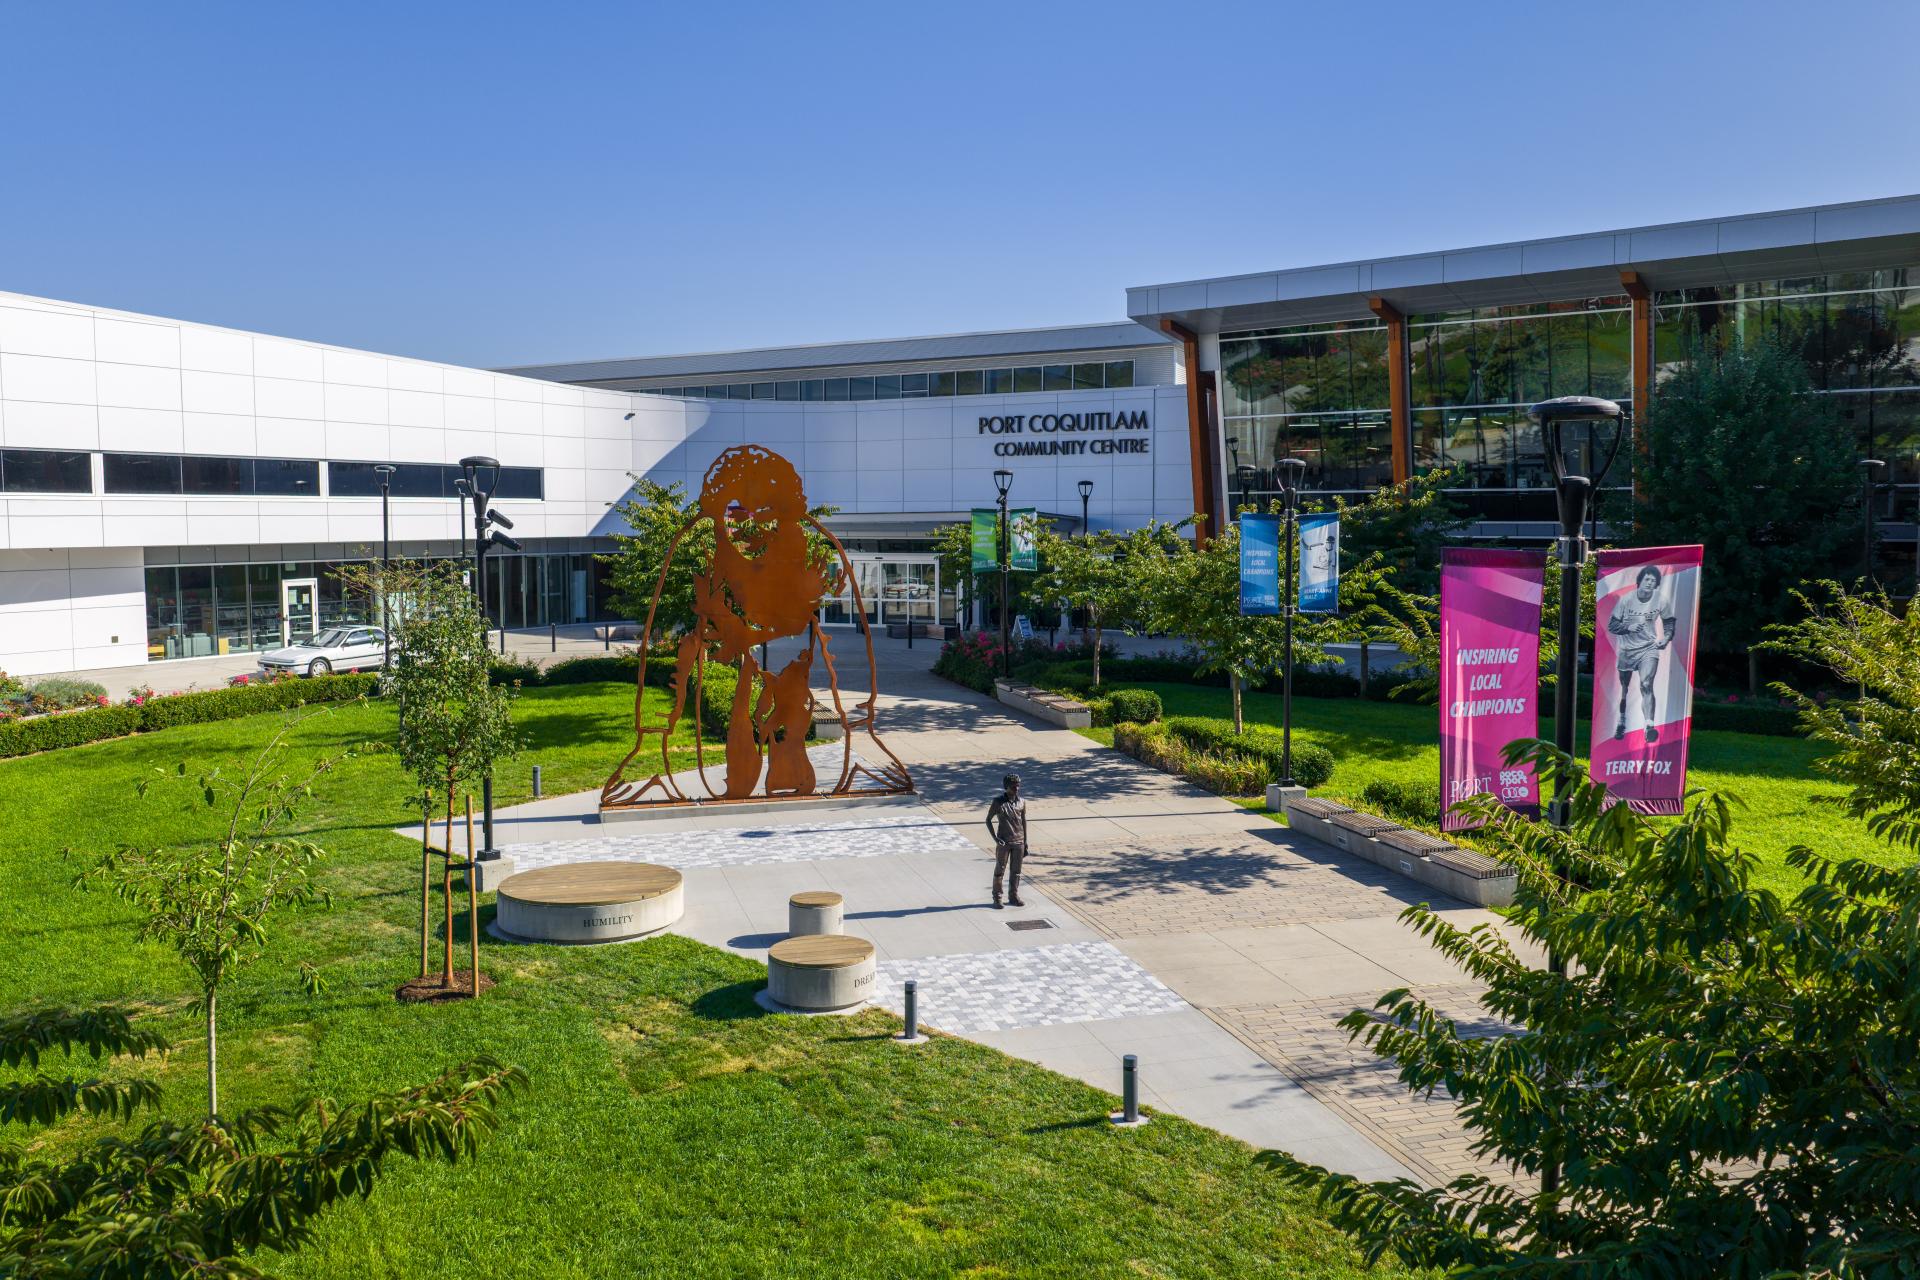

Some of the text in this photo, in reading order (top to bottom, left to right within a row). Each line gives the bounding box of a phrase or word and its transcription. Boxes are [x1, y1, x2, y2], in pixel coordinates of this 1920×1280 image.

[978, 410, 1150, 435] PORT COQUITLAM
[994, 438, 1150, 457] COMMUNITY CENTRE
[1456, 648, 1520, 666] INSPIRING
[1470, 673, 1503, 691] LOCAL
[1450, 698, 1527, 718] CHAMPIONS
[1605, 760, 1673, 776] TERRY FOX
[583, 914, 635, 928] HUMILITY
